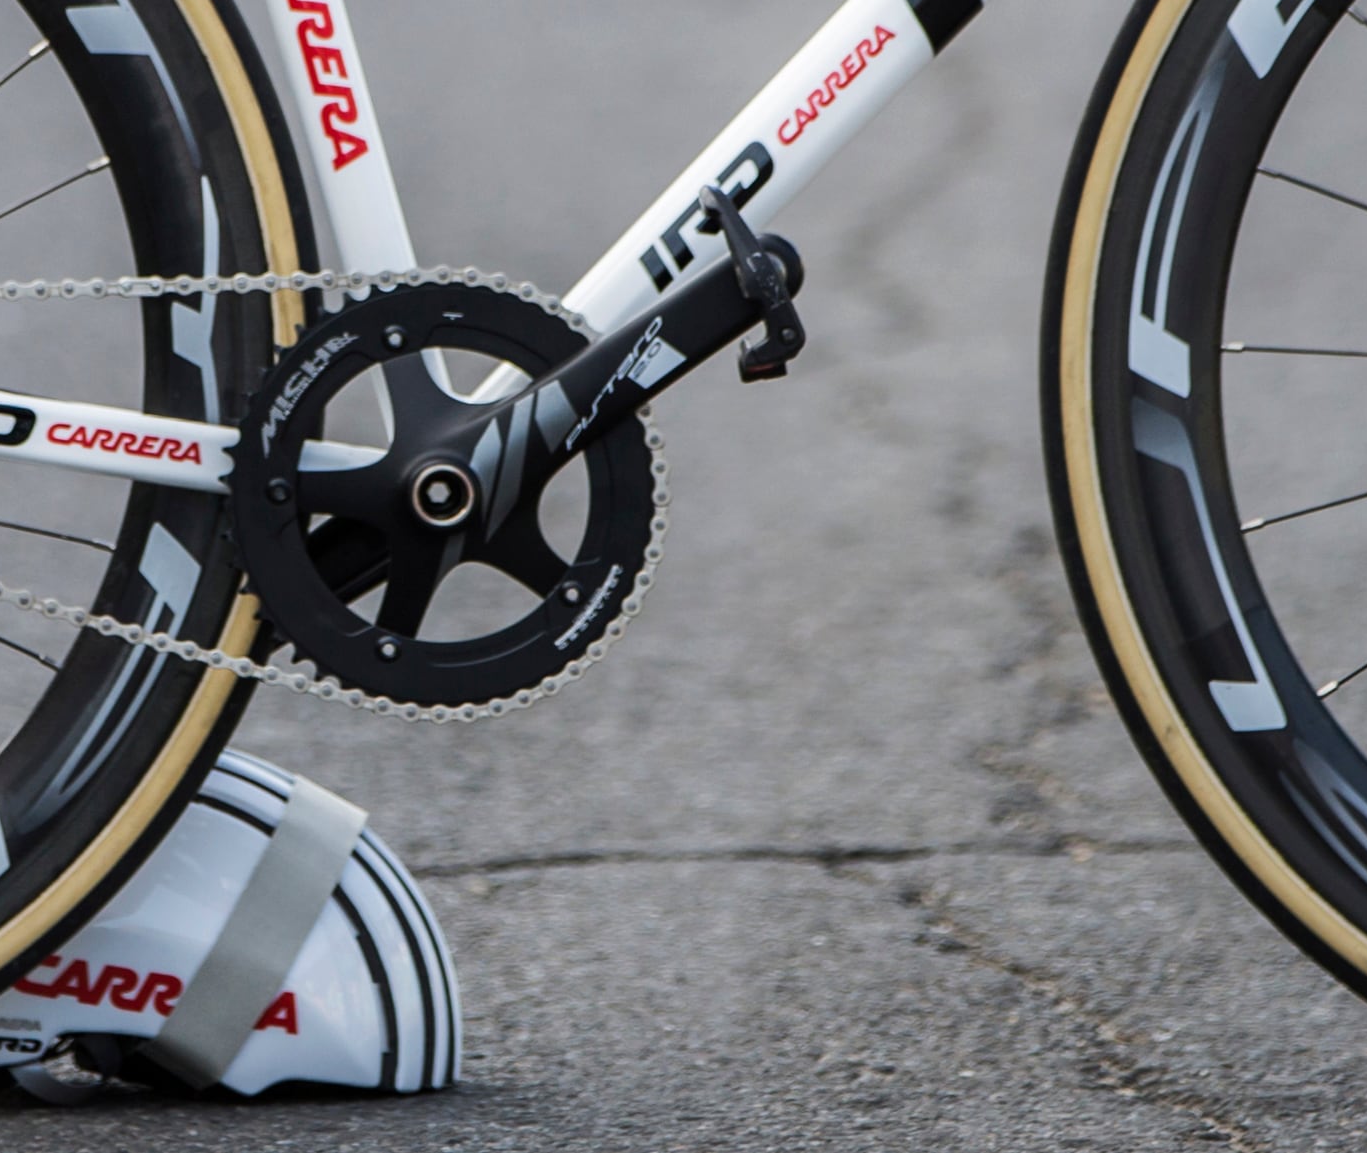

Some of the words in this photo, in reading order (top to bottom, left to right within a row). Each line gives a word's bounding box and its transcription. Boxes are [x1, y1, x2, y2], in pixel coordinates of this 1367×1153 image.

[639, 141, 774, 294] IRD
[777, 25, 896, 146] CARRERA
[46, 422, 202, 466] CARRERA
[14, 954, 298, 1036] CARRA
